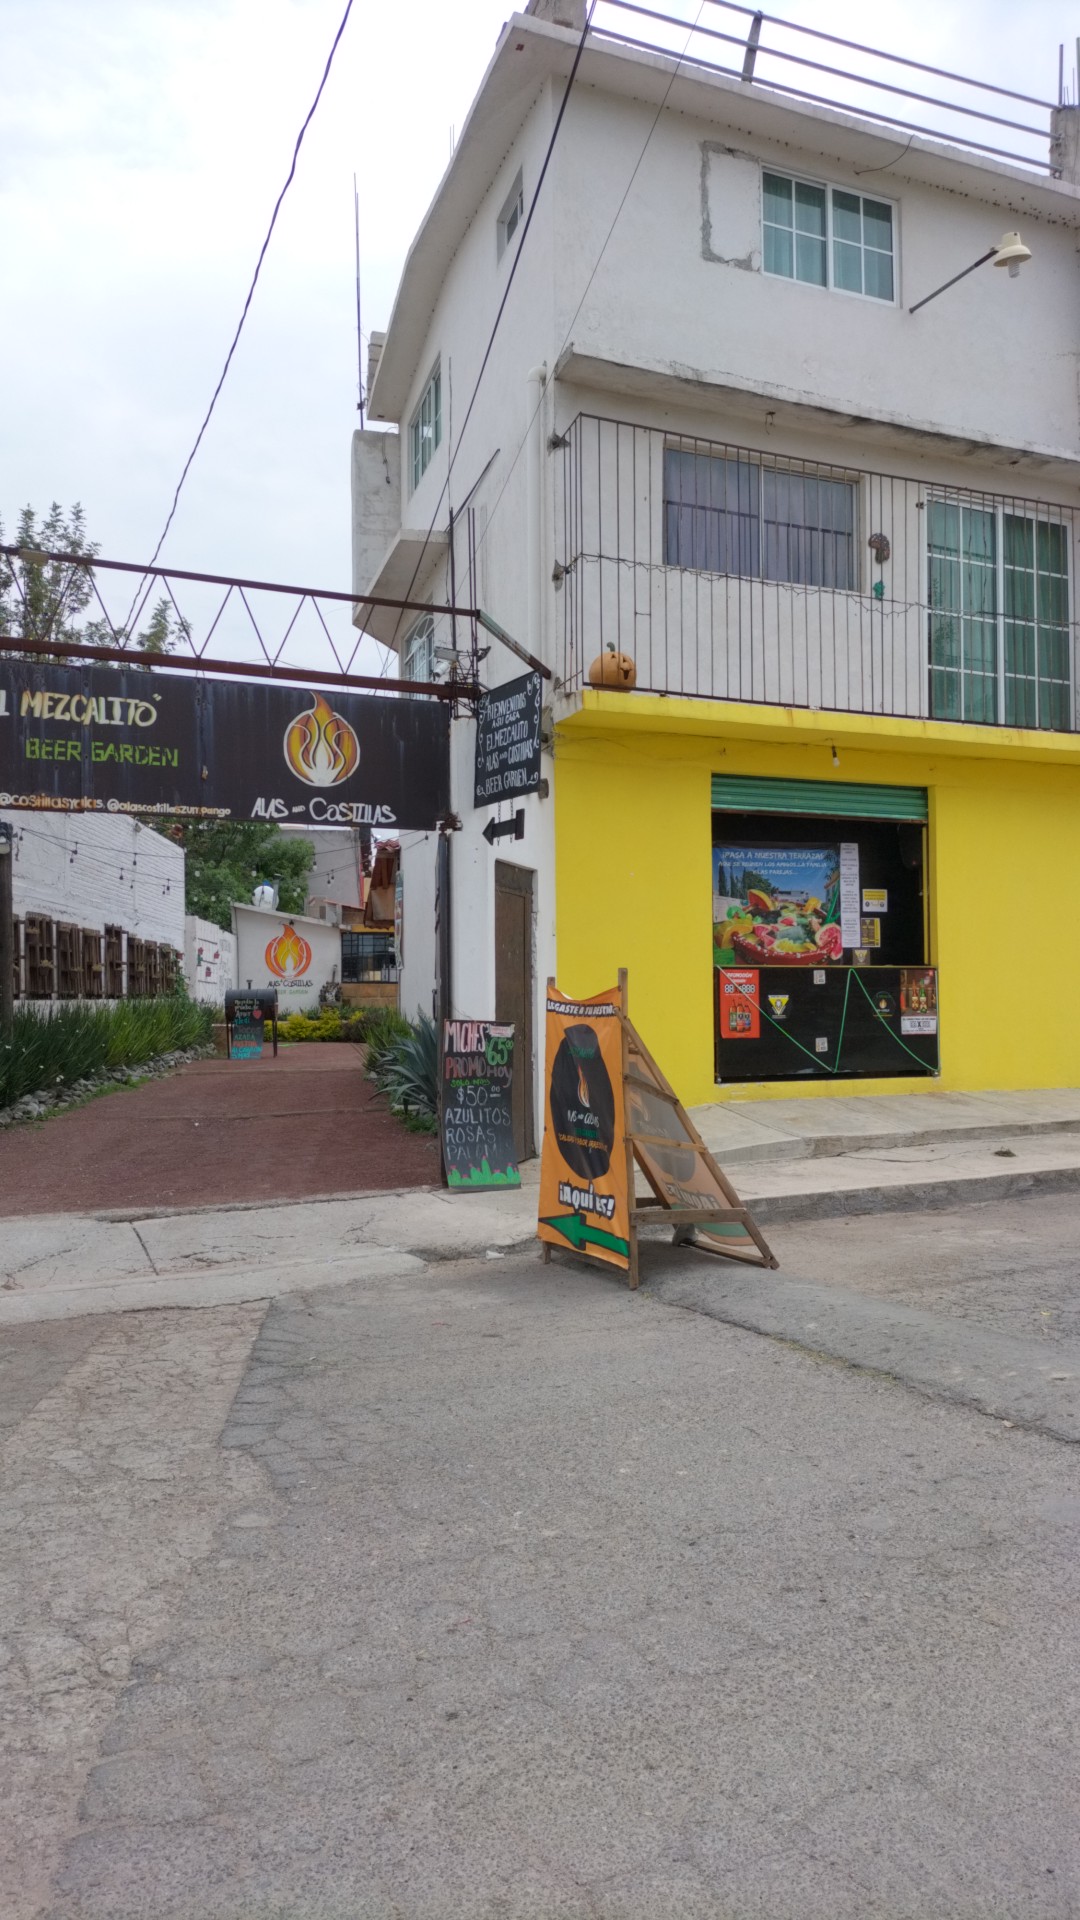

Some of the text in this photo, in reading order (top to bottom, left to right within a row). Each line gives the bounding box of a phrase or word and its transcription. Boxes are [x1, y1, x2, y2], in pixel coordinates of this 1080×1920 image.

[0, 690, 10, 716] L
[505, 711, 520, 722] CASA
[25, 738, 179, 767] BEER GARDEN
[485, 767, 528, 795] BEER GARDEN
[251, 797, 289, 819] ALAS
[746, 852, 753, 860] A
[754, 852, 788, 860] NUESTRA
[444, 1020, 487, 1053] MICHES
[445, 1056, 487, 1080] PROMO
[445, 1107, 511, 1126] AZULITOS
[446, 1125, 497, 1145] ROSAS
